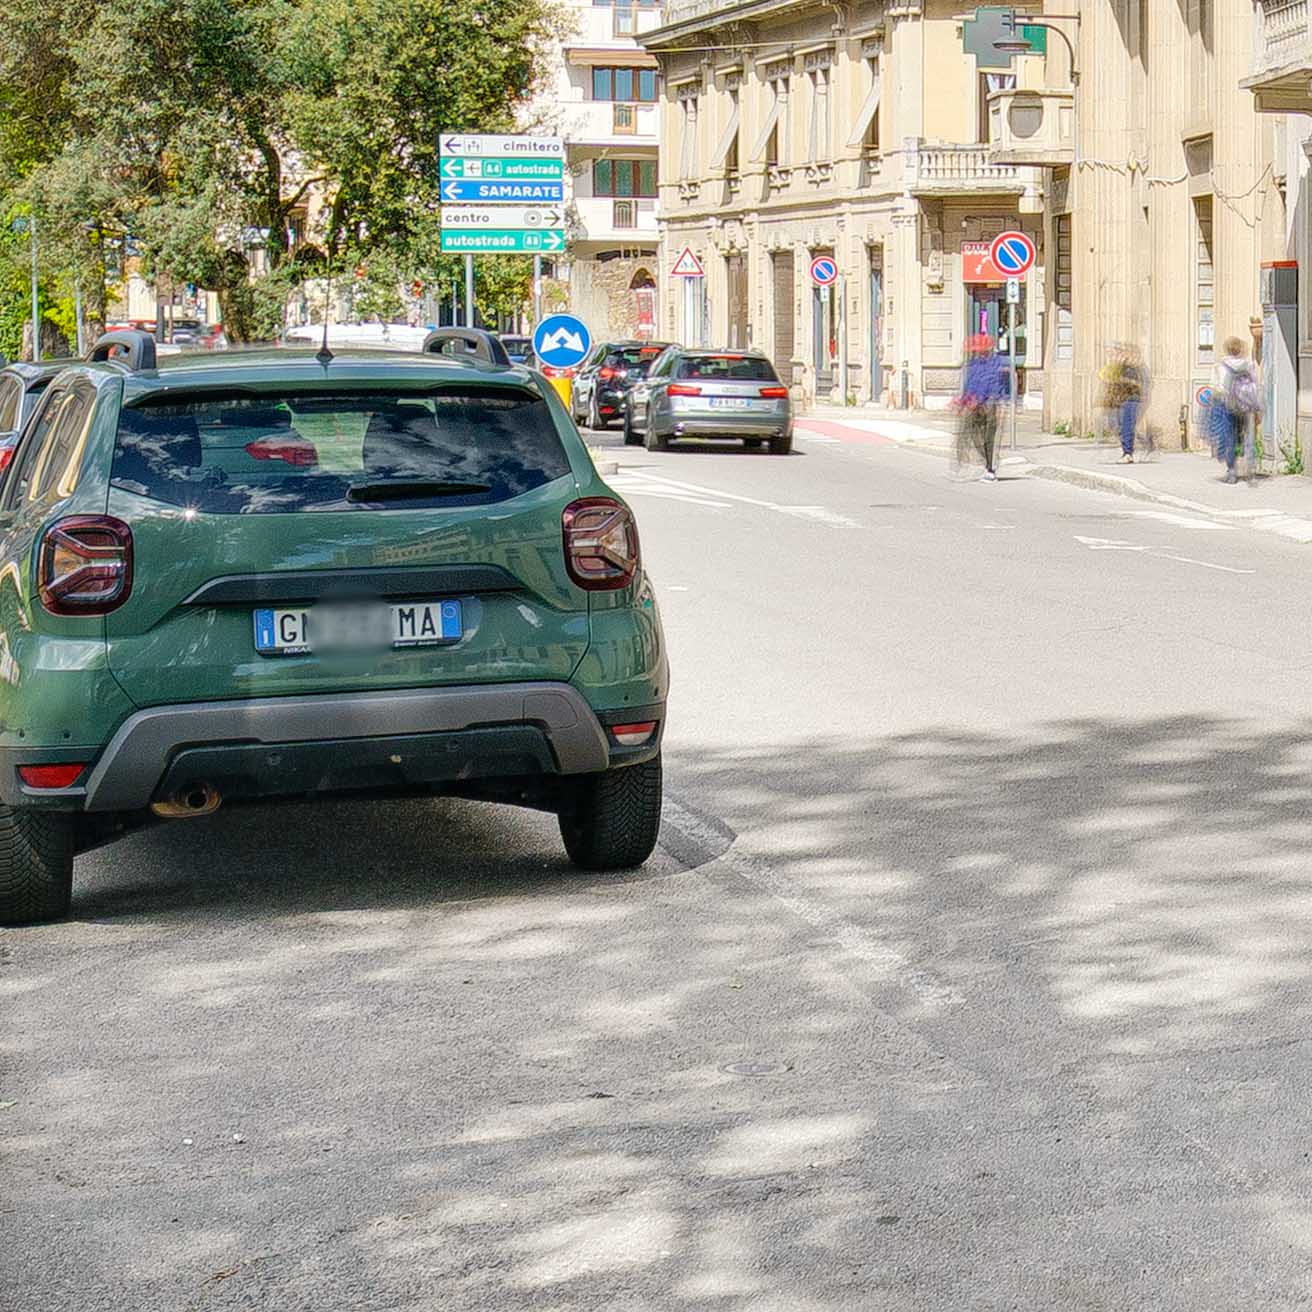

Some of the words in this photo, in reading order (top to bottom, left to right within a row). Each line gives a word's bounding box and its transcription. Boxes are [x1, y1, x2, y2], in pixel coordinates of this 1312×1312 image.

[503, 141, 560, 152] cimitero
[505, 163, 560, 175] autostrada
[479, 185, 560, 198] SAMARATE
[445, 213, 490, 223] centro
[445, 235, 516, 247] autostrada
[399, 607, 436, 637] MA
